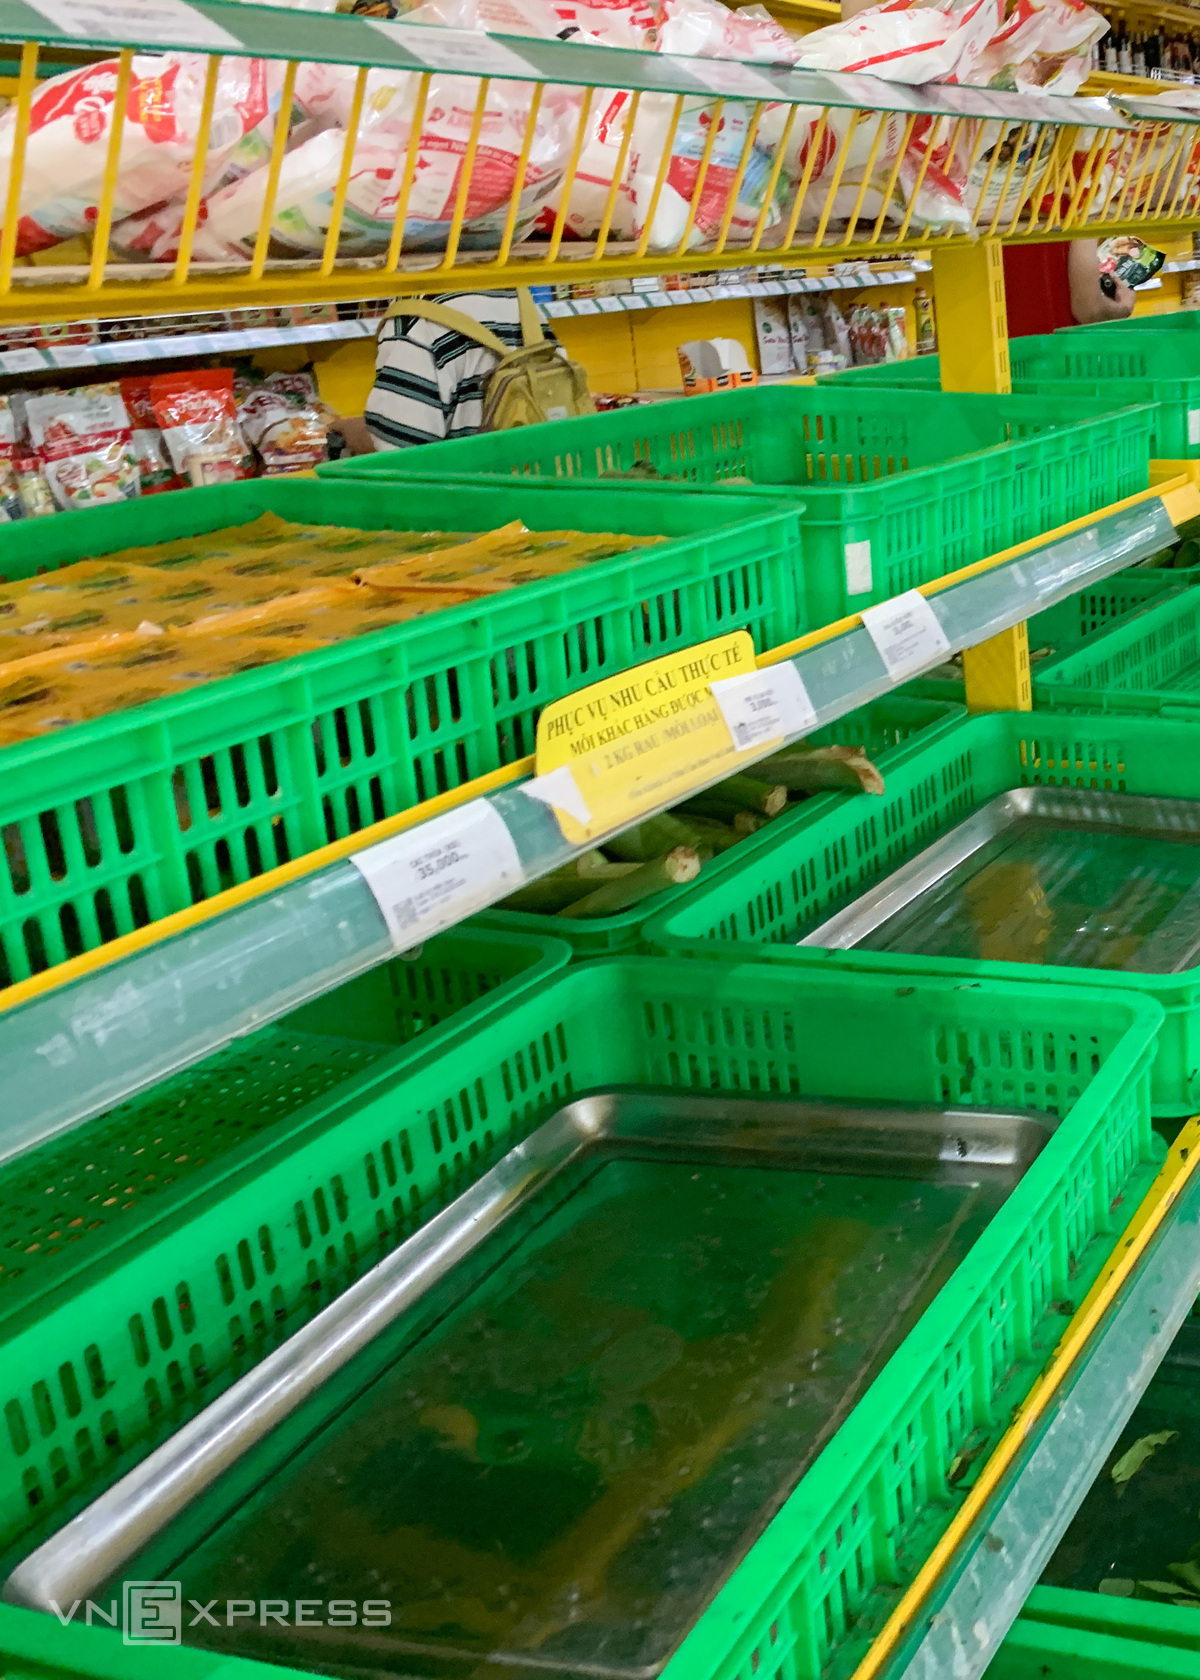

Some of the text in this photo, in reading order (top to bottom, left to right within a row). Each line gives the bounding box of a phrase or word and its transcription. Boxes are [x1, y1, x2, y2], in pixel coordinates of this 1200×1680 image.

[547, 707, 585, 741] PHỤC
[587, 696, 609, 722] VỤ
[610, 684, 643, 708] NHU
[678, 651, 722, 684] THỰC
[724, 641, 743, 667] TẾ
[634, 701, 670, 730] HÀNG
